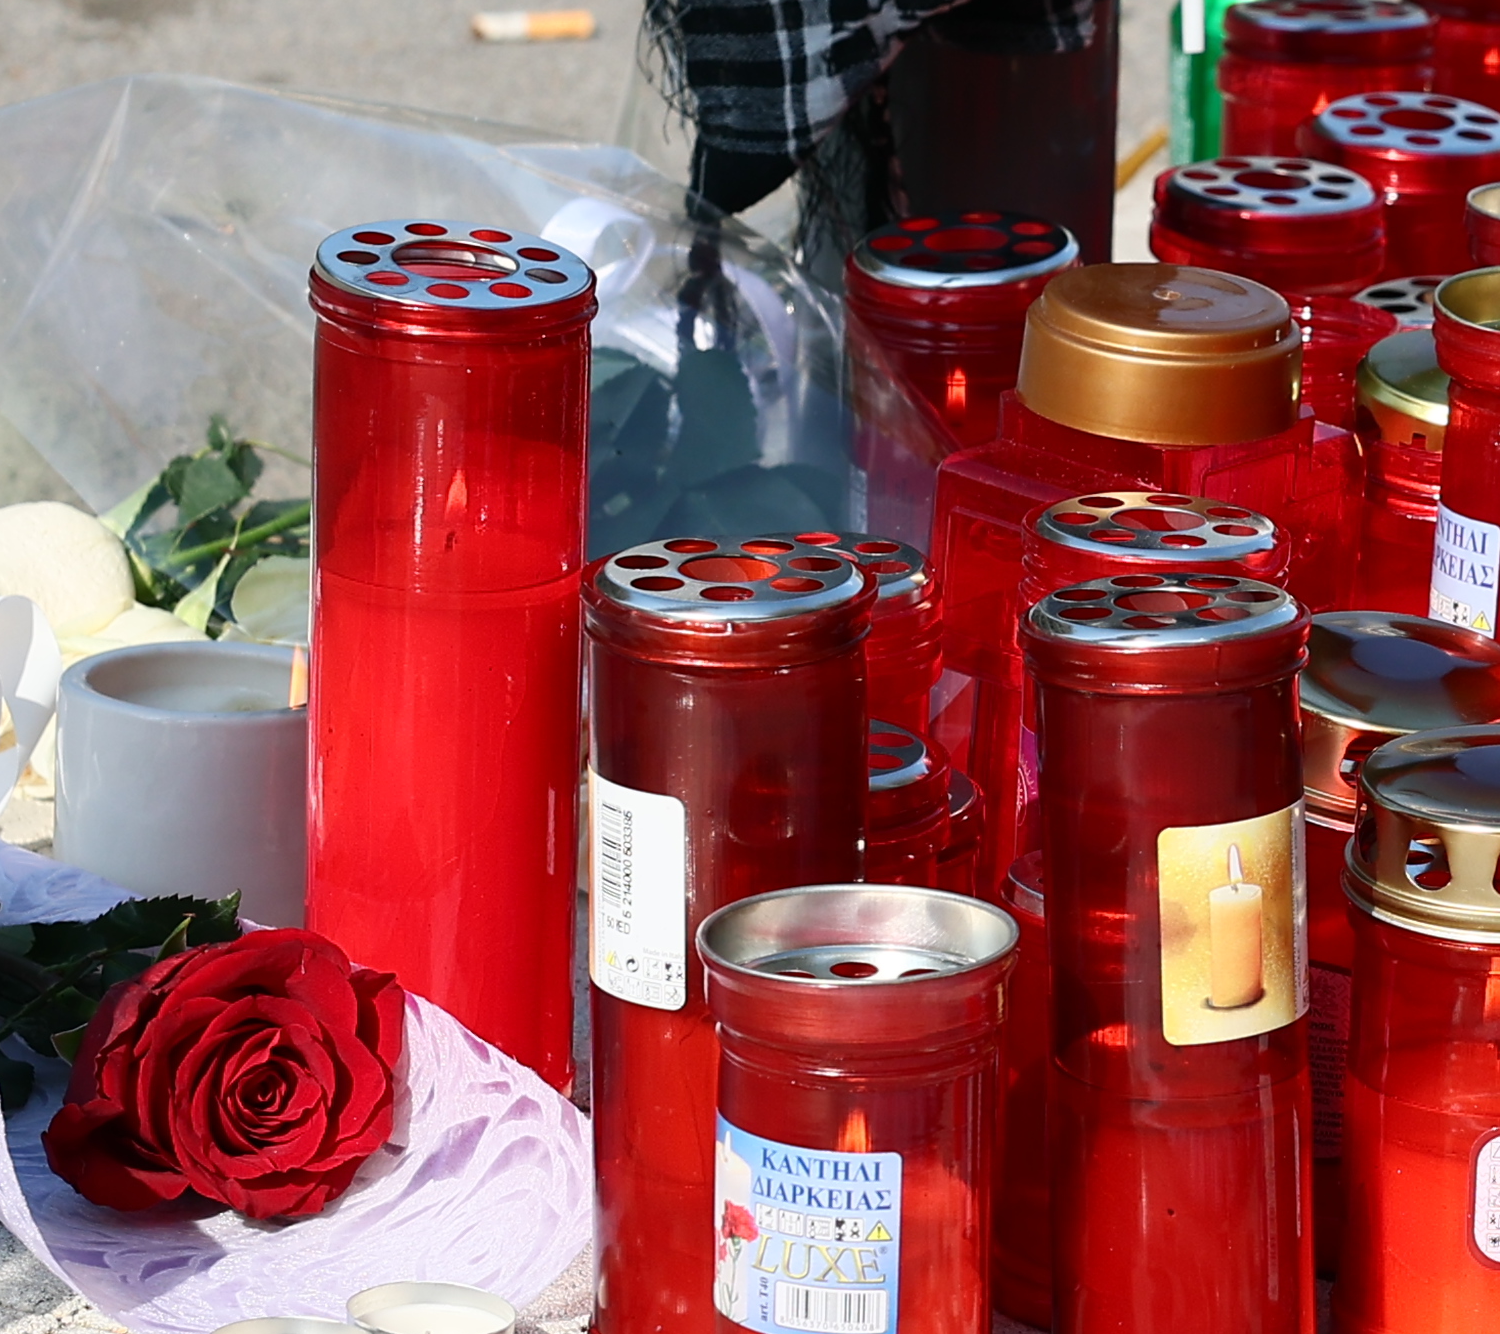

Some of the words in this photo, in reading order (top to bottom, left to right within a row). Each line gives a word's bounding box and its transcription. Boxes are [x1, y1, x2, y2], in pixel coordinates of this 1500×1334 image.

[761, 1147, 881, 1182] ΚΑΝΤΗΛΙ
[752, 1175, 892, 1210] ΔΙΑΡΚΕΙΑΣ
[751, 1233, 886, 1285] LUXE
